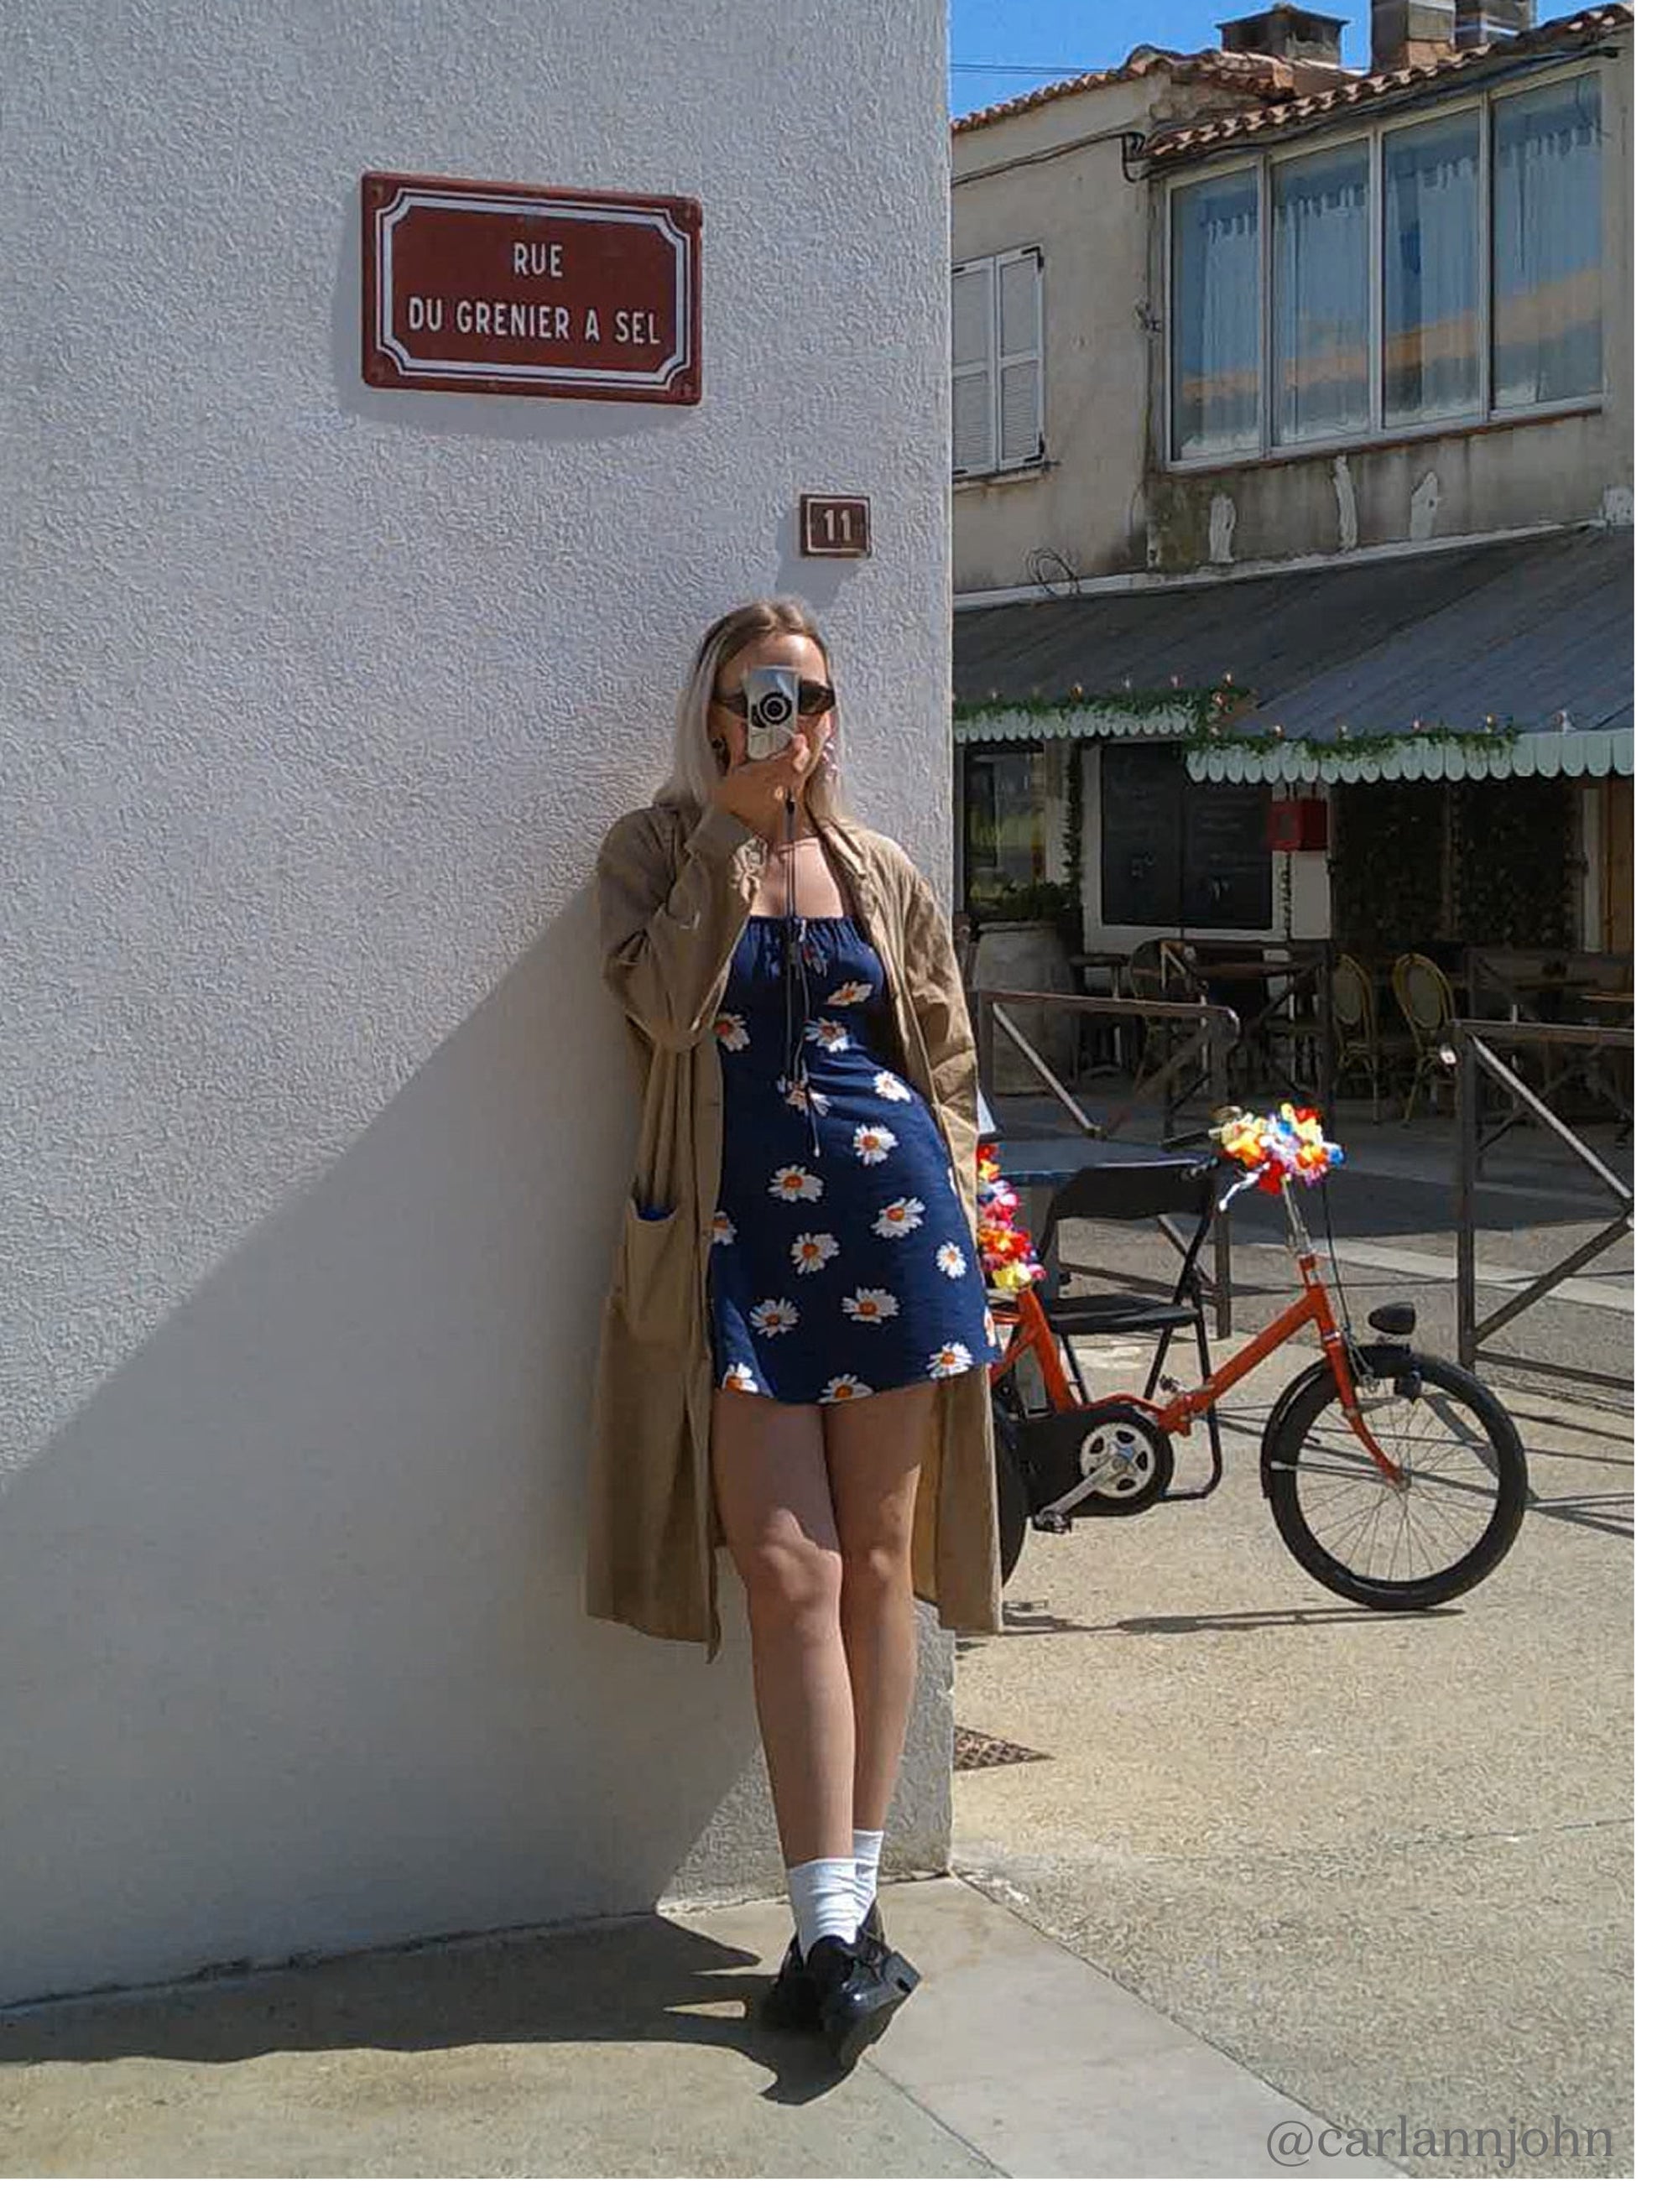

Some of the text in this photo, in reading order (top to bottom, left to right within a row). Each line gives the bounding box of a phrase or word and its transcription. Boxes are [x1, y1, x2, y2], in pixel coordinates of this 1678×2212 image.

[513, 242, 563, 277] RUE
[409, 297, 660, 345] DU GRENIER A SEL
[824, 509, 851, 541] 11
